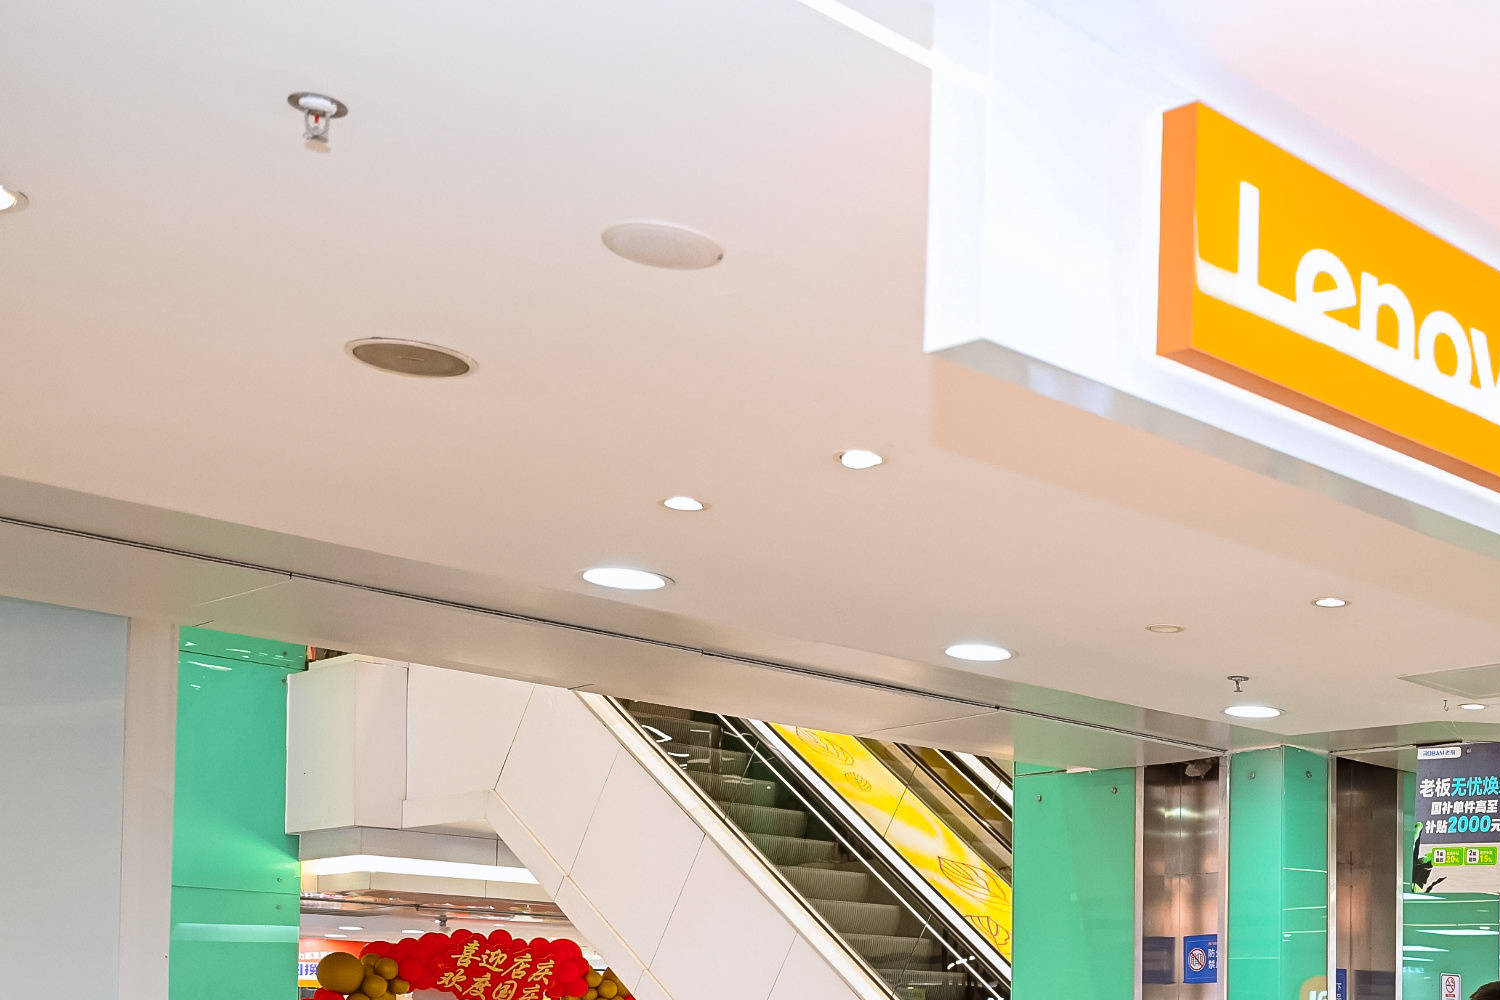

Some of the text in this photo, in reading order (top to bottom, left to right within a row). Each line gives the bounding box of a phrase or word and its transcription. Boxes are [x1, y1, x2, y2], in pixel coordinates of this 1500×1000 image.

[1431, 799, 1498, 815] 国补单件高至
[450, 940, 555, 985] 喜迎店庆
